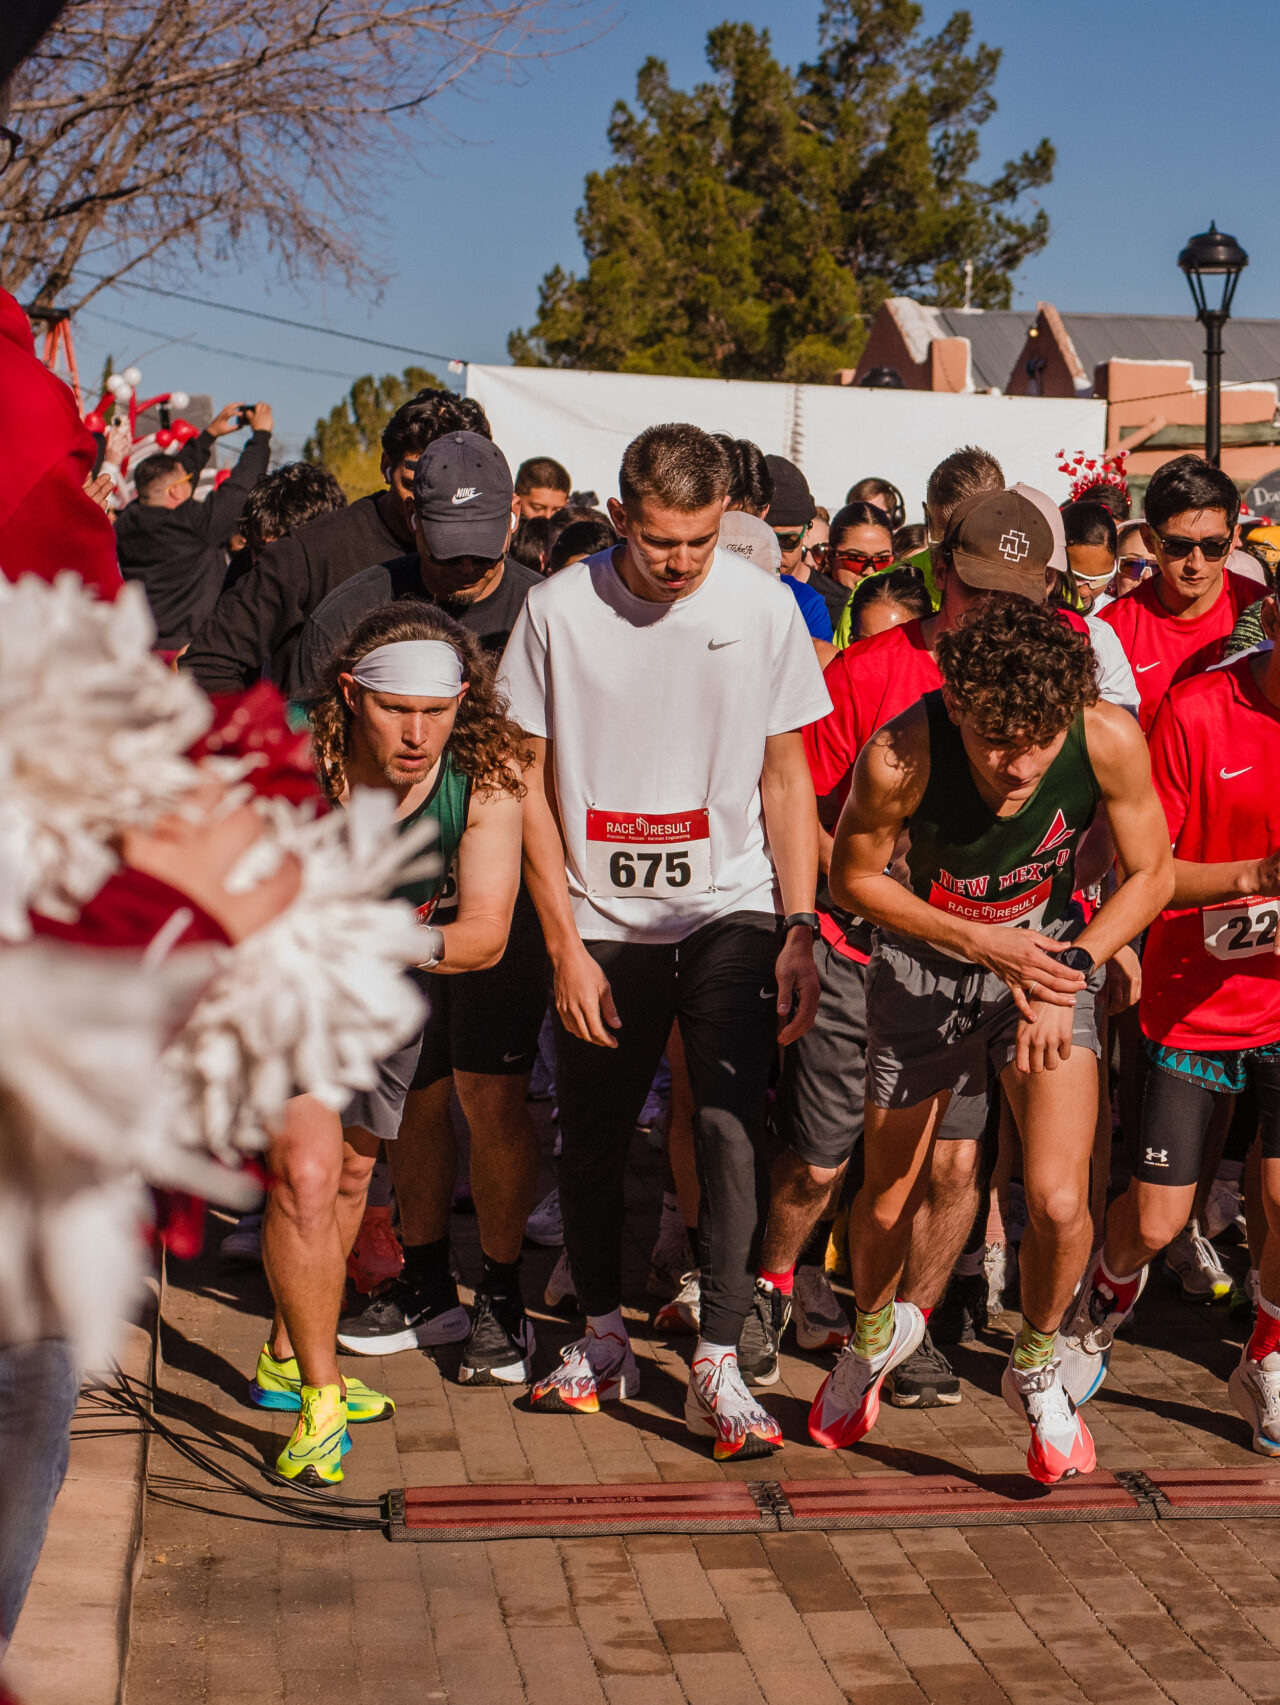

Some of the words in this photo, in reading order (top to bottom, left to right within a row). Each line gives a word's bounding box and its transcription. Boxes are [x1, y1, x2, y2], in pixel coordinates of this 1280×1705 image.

[456, 488, 476, 498] NIKE
[606, 822, 636, 834] RACE
[650, 822, 692, 835] RESULT
[610, 850, 692, 888] 675
[939, 868, 990, 897] NEW
[998, 848, 1070, 892] MEXO
[948, 901, 980, 918] RACE
[997, 894, 1037, 918] RESULT
[1228, 910, 1280, 951] 22
[582, 1496, 646, 1504] result
